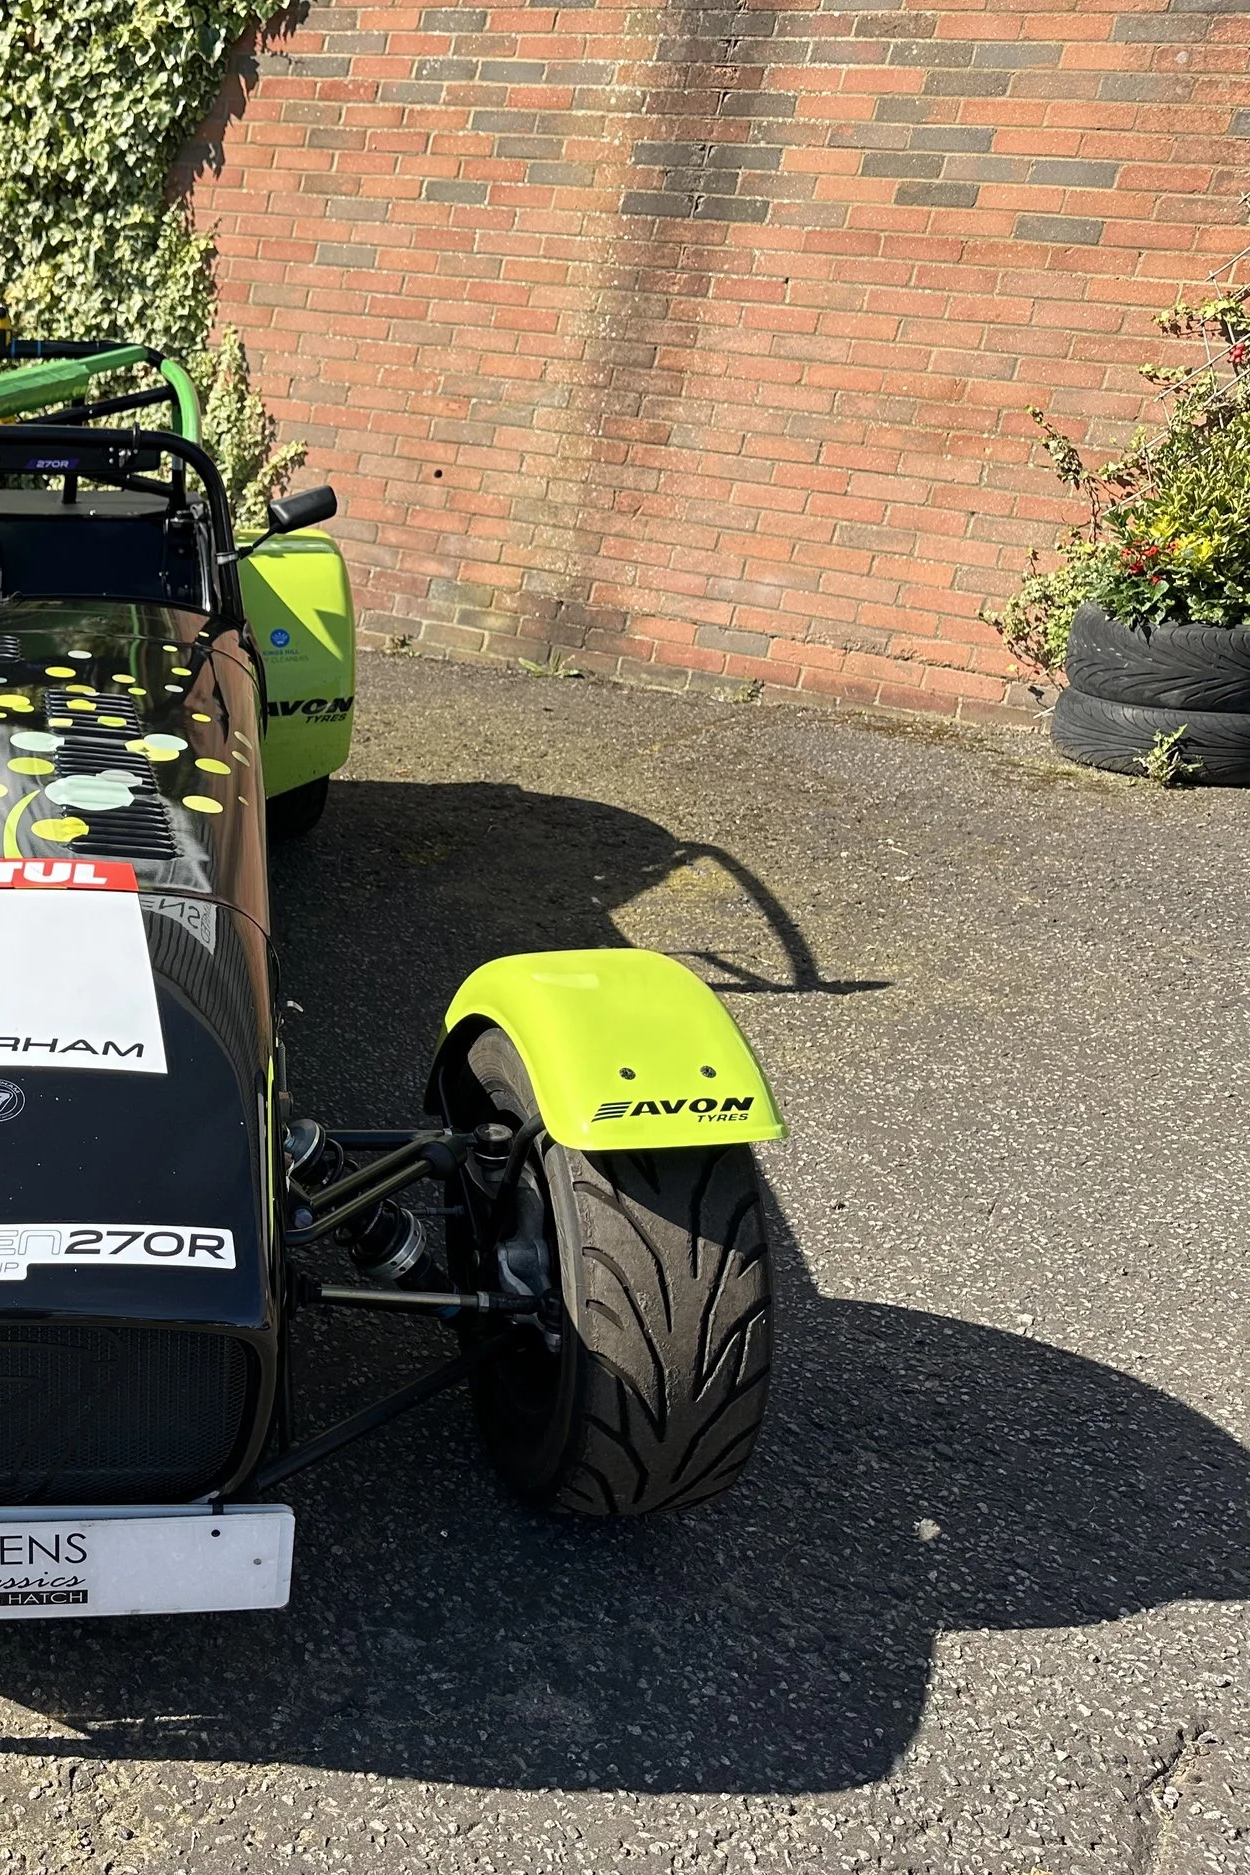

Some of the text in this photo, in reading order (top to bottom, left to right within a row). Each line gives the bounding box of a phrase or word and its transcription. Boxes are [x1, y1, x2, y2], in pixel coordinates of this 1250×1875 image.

[36, 460, 69, 468] 270R
[306, 713, 347, 724] TYRES
[629, 1097, 755, 1116] AVON
[697, 1113, 749, 1123] TYRES
[8, 1592, 83, 1605] HATCH
